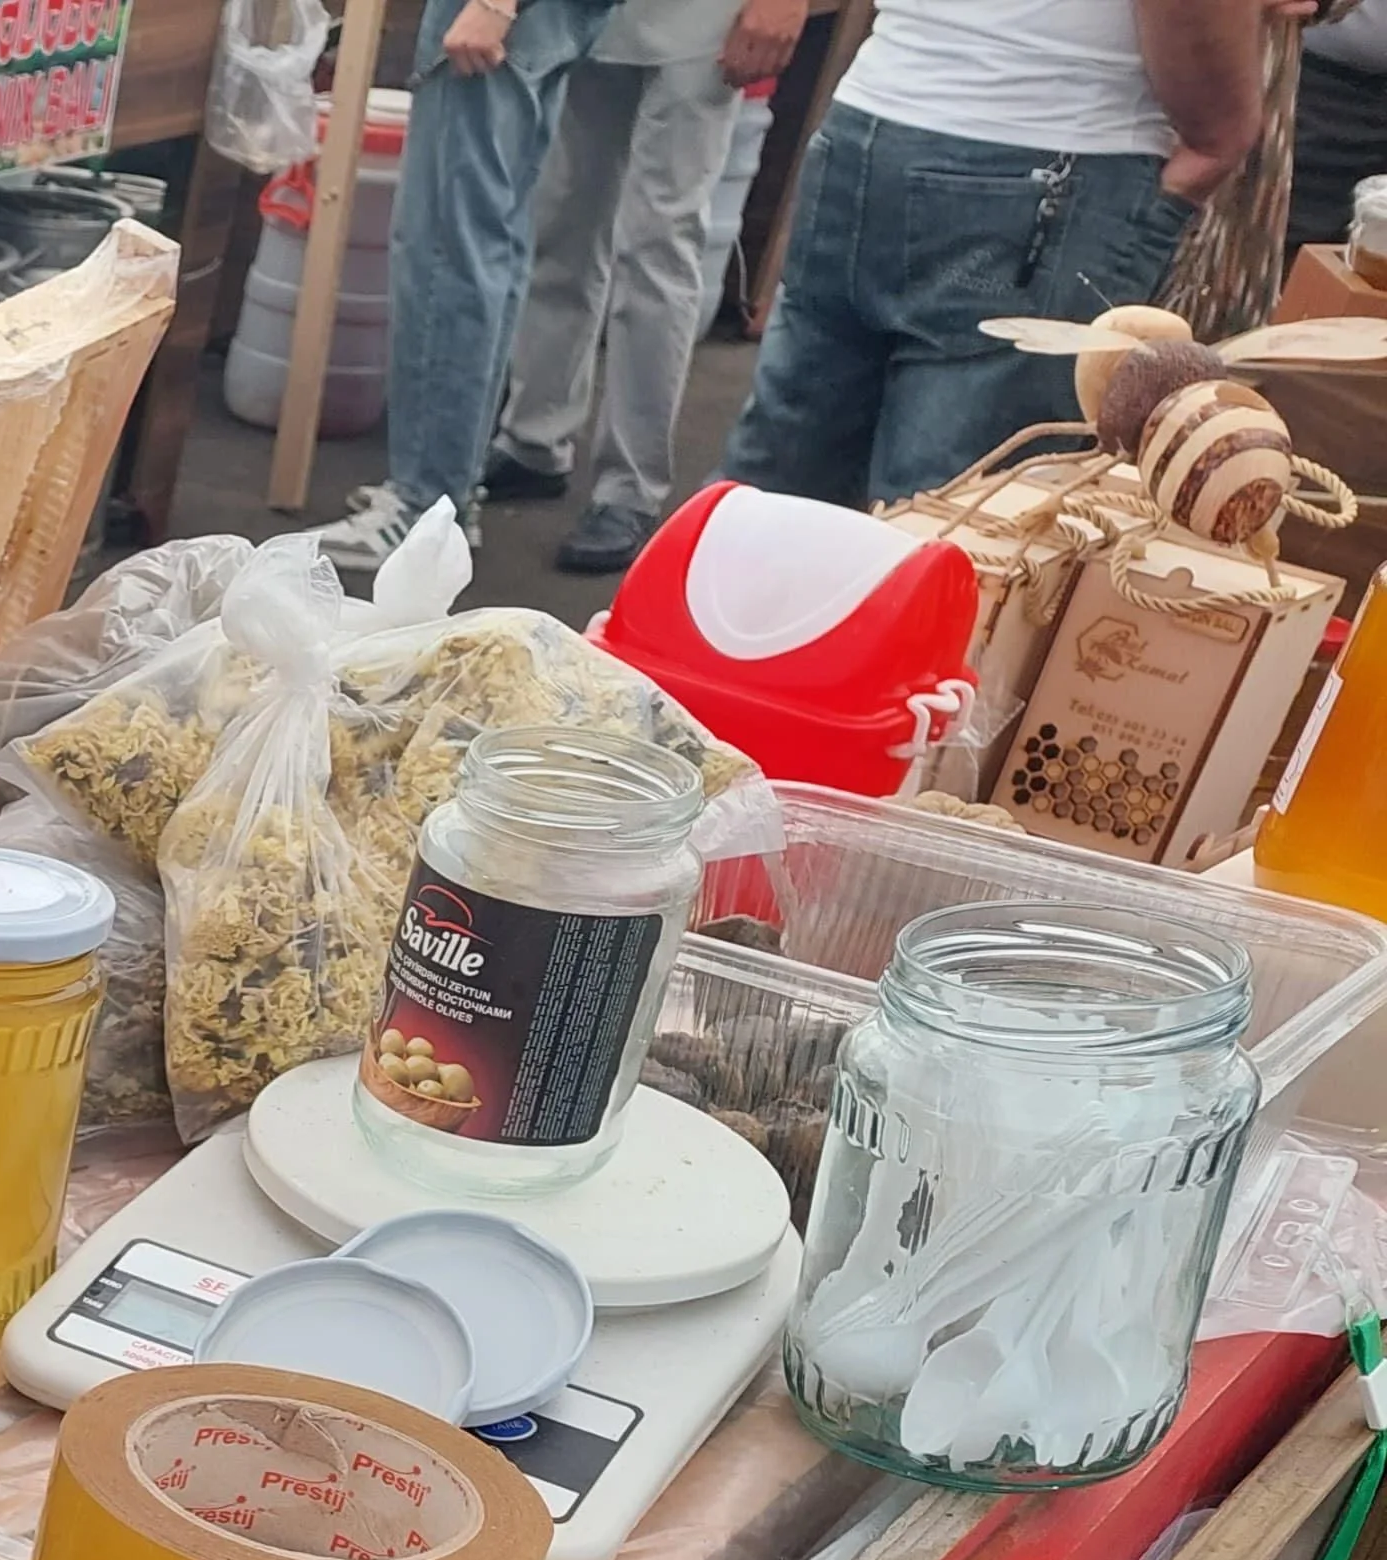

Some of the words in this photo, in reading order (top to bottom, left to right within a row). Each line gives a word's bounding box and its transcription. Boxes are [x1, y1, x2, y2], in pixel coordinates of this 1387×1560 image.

[41, 55, 115, 139] BALI
[400, 905, 485, 977] Saville
[406, 985, 435, 1011] WHOLE
[435, 1003, 474, 1024] OLIVES
[436, 991, 513, 1020] КОСТОЧКАМИ
[447, 979, 492, 1003] ZEYTUN
[260, 1471, 348, 1512] Prestij
[352, 1453, 427, 1507] Prestij
[193, 1506, 255, 1530] restij
